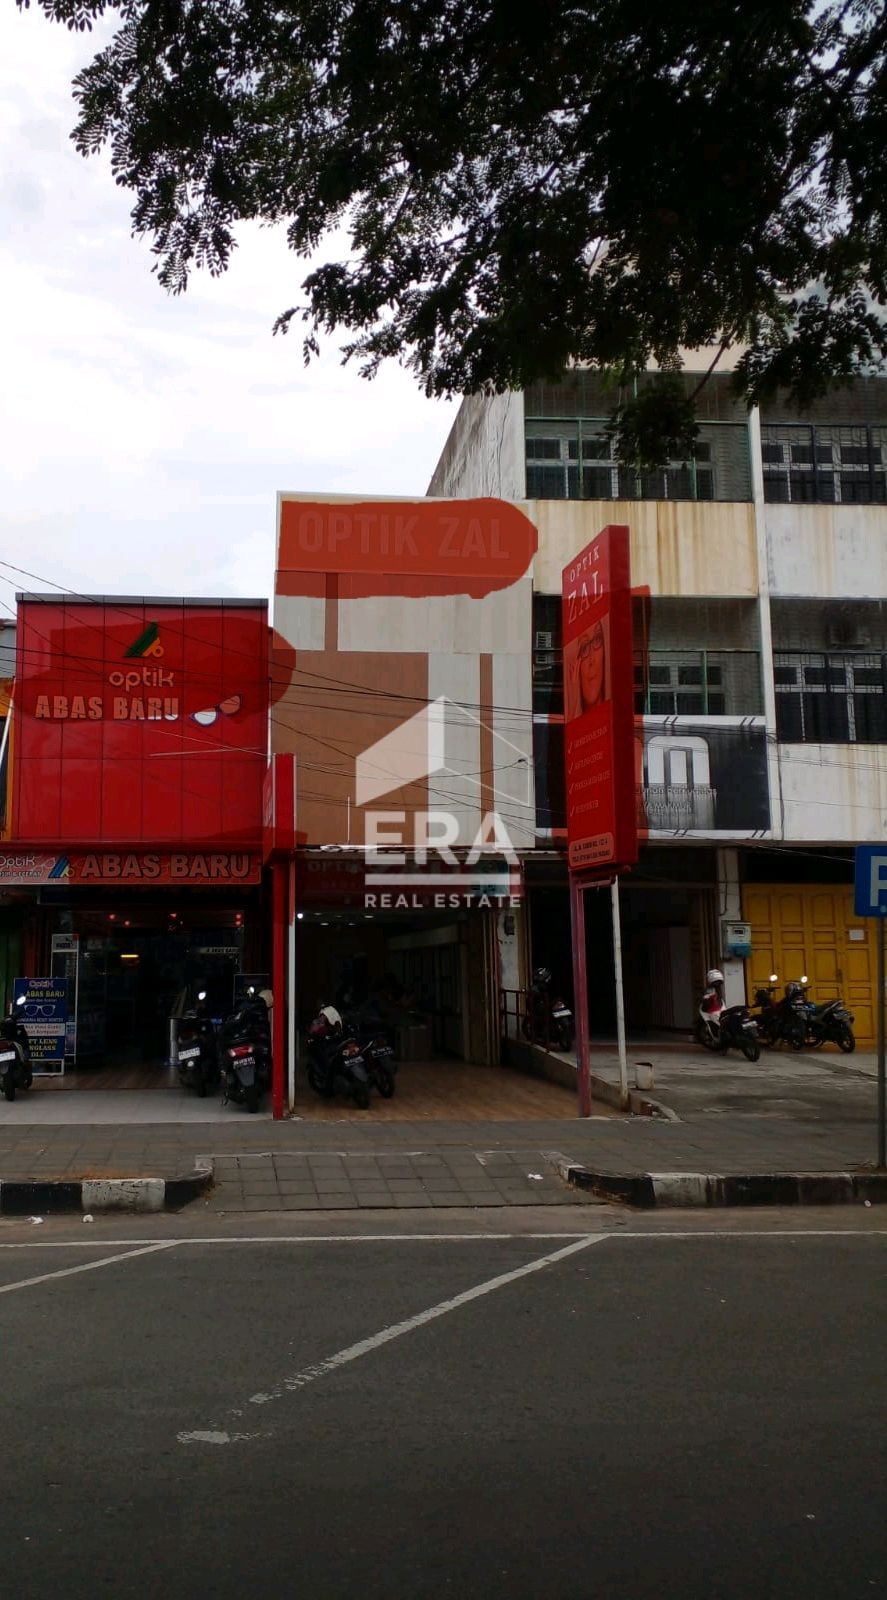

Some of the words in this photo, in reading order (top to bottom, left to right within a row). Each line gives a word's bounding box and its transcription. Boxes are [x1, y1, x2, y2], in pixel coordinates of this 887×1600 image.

[297, 510, 420, 557] OPTIK
[437, 516, 511, 560] ZAL
[568, 548, 601, 585] OPTIK
[567, 569, 605, 625] ZAL
[108, 667, 175, 692] optik
[34, 695, 104, 720] ABAS
[113, 696, 180, 721] BARU
[80, 854, 160, 878] ABAS
[170, 854, 250, 878] BARU
[45, 990, 65, 998] BARU
